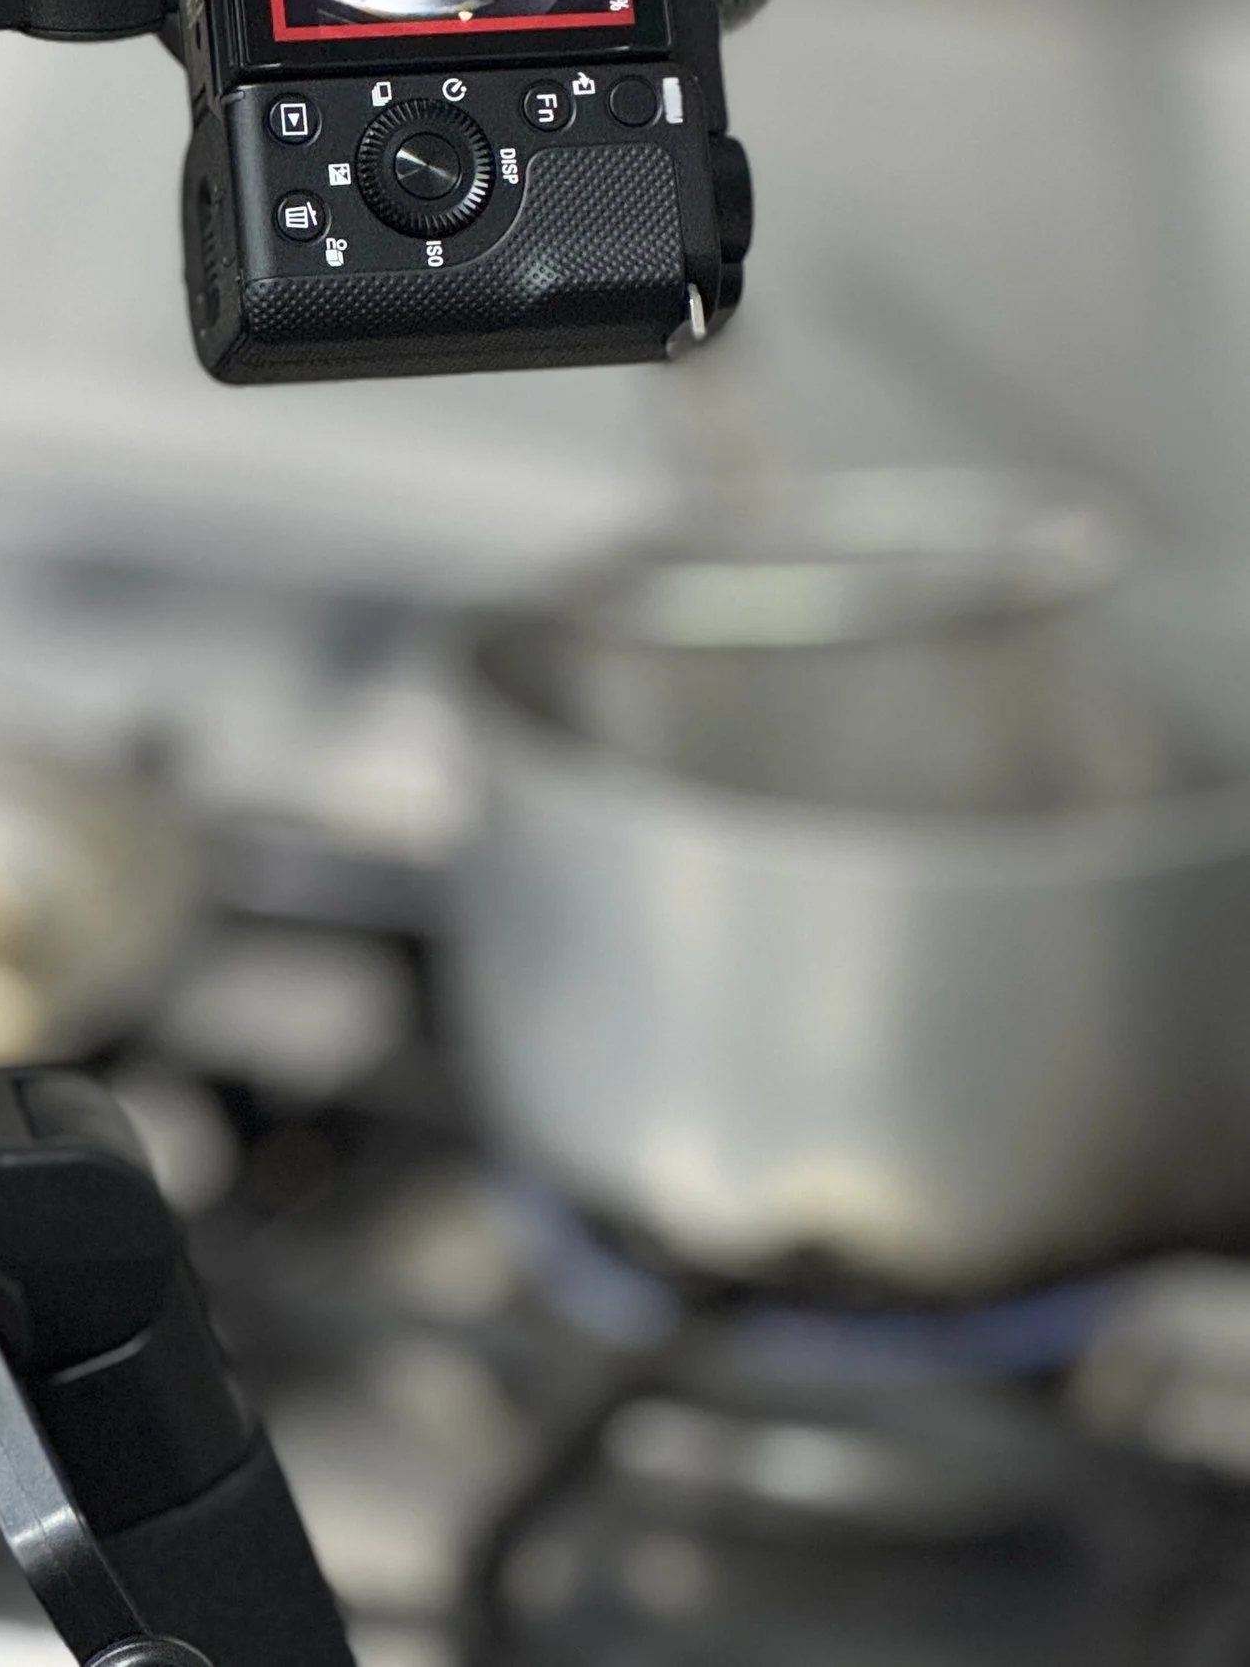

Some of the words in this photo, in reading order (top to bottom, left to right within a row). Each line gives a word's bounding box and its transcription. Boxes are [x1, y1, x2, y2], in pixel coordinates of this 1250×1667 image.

[536, 92, 557, 122] Fn
[499, 147, 519, 185] DISP
[426, 240, 444, 268] ISO
